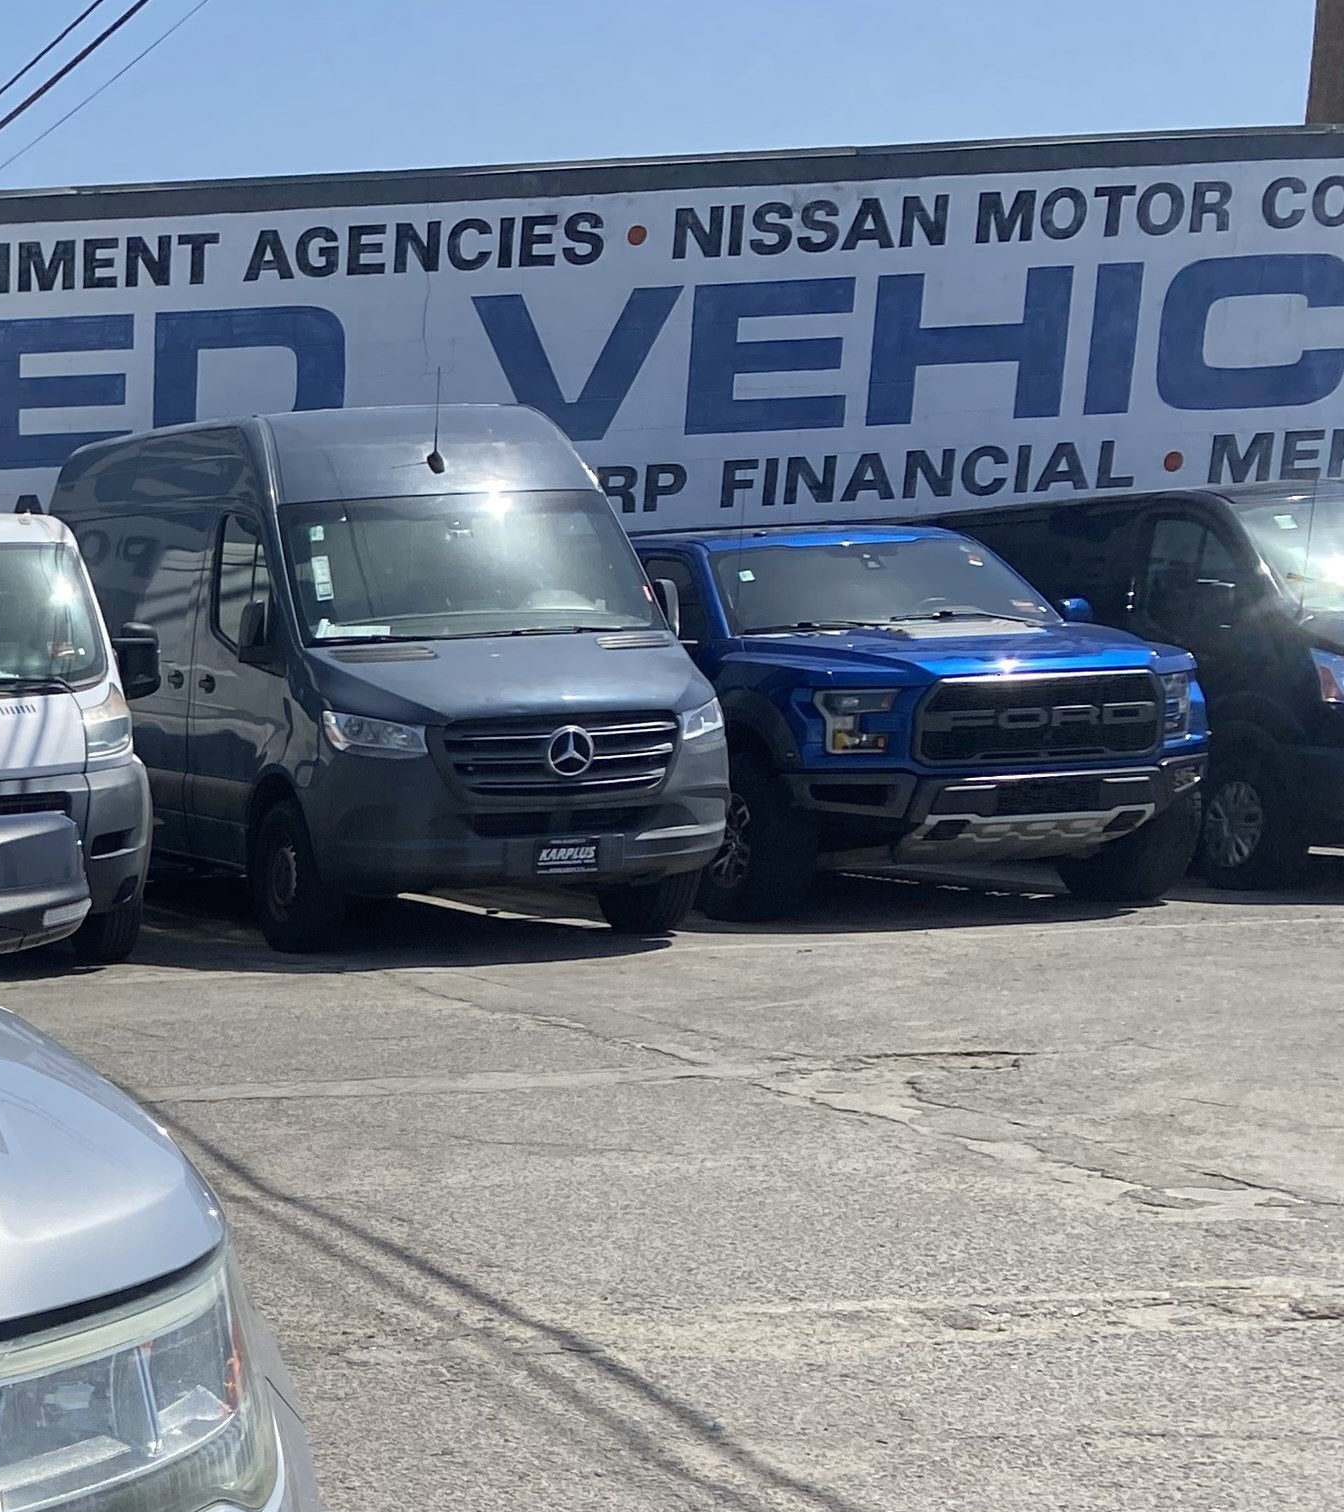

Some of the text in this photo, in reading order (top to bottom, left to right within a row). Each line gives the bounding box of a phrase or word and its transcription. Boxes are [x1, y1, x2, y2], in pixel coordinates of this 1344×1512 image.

[243, 212, 604, 281] AGENCIES
[672, 193, 948, 259] NISSAN
[975, 179, 1232, 245] MOTOR
[472, 252, 1344, 441] VEHIC
[720, 440, 1134, 508] FINANCIAL
[921, 701, 1156, 732] FORD
[539, 846, 596, 861] KARPLUS
